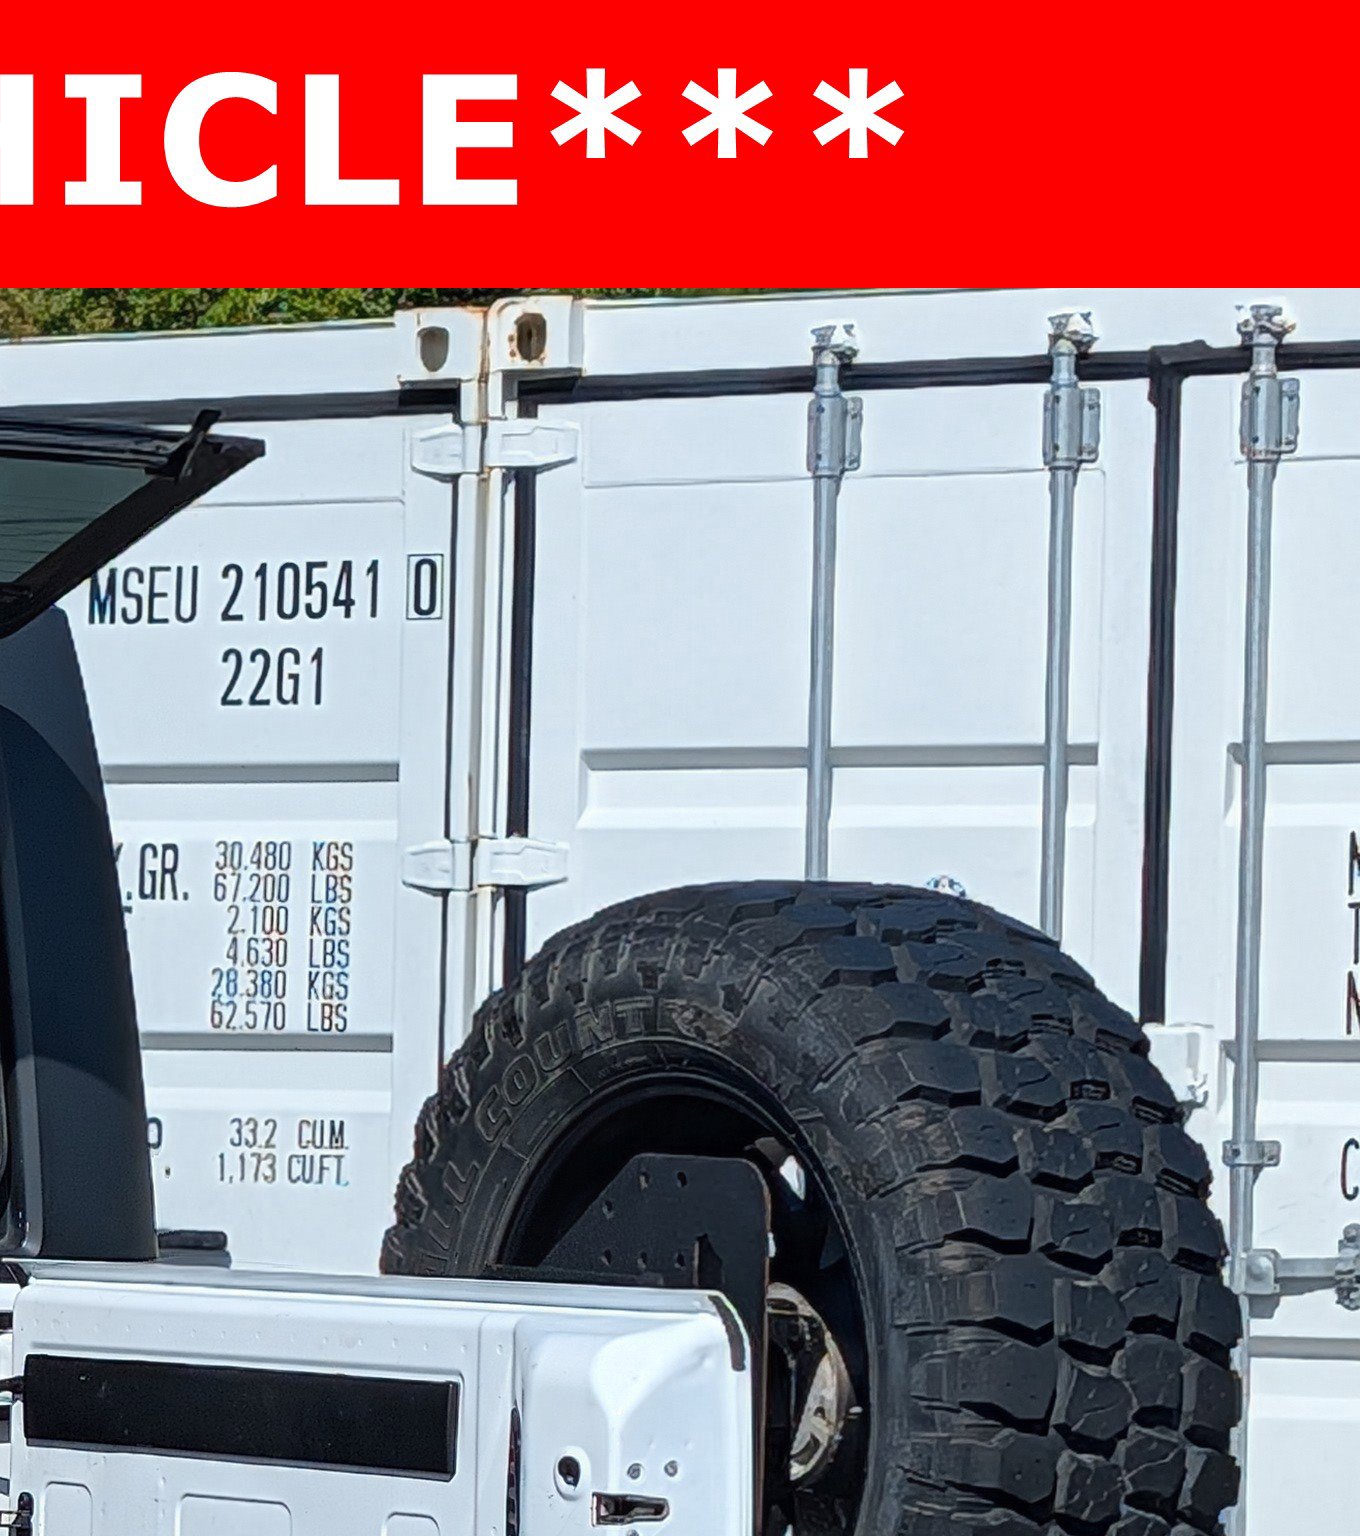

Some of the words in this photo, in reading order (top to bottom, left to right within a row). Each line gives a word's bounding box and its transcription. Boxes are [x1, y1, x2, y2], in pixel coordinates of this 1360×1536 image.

[87, 565, 199, 625] MSEU
[220, 558, 379, 622] 210541
[411, 556, 439, 618] 0
[220, 646, 324, 706] 22G1
[214, 841, 292, 871] 30.480
[311, 841, 353, 872] KGS
[213, 873, 290, 903] 67.200
[310, 874, 352, 904] LBS
[227, 905, 289, 936] 2.100
[309, 906, 351, 937] KGS
[225, 937, 288, 968] 4.630
[308, 938, 350, 969] LBS
[307, 970, 349, 1001] KGS
[210, 1000, 286, 1031] 62.570
[306, 1002, 348, 1033] LBS
[229, 1117, 278, 1149] 33.2
